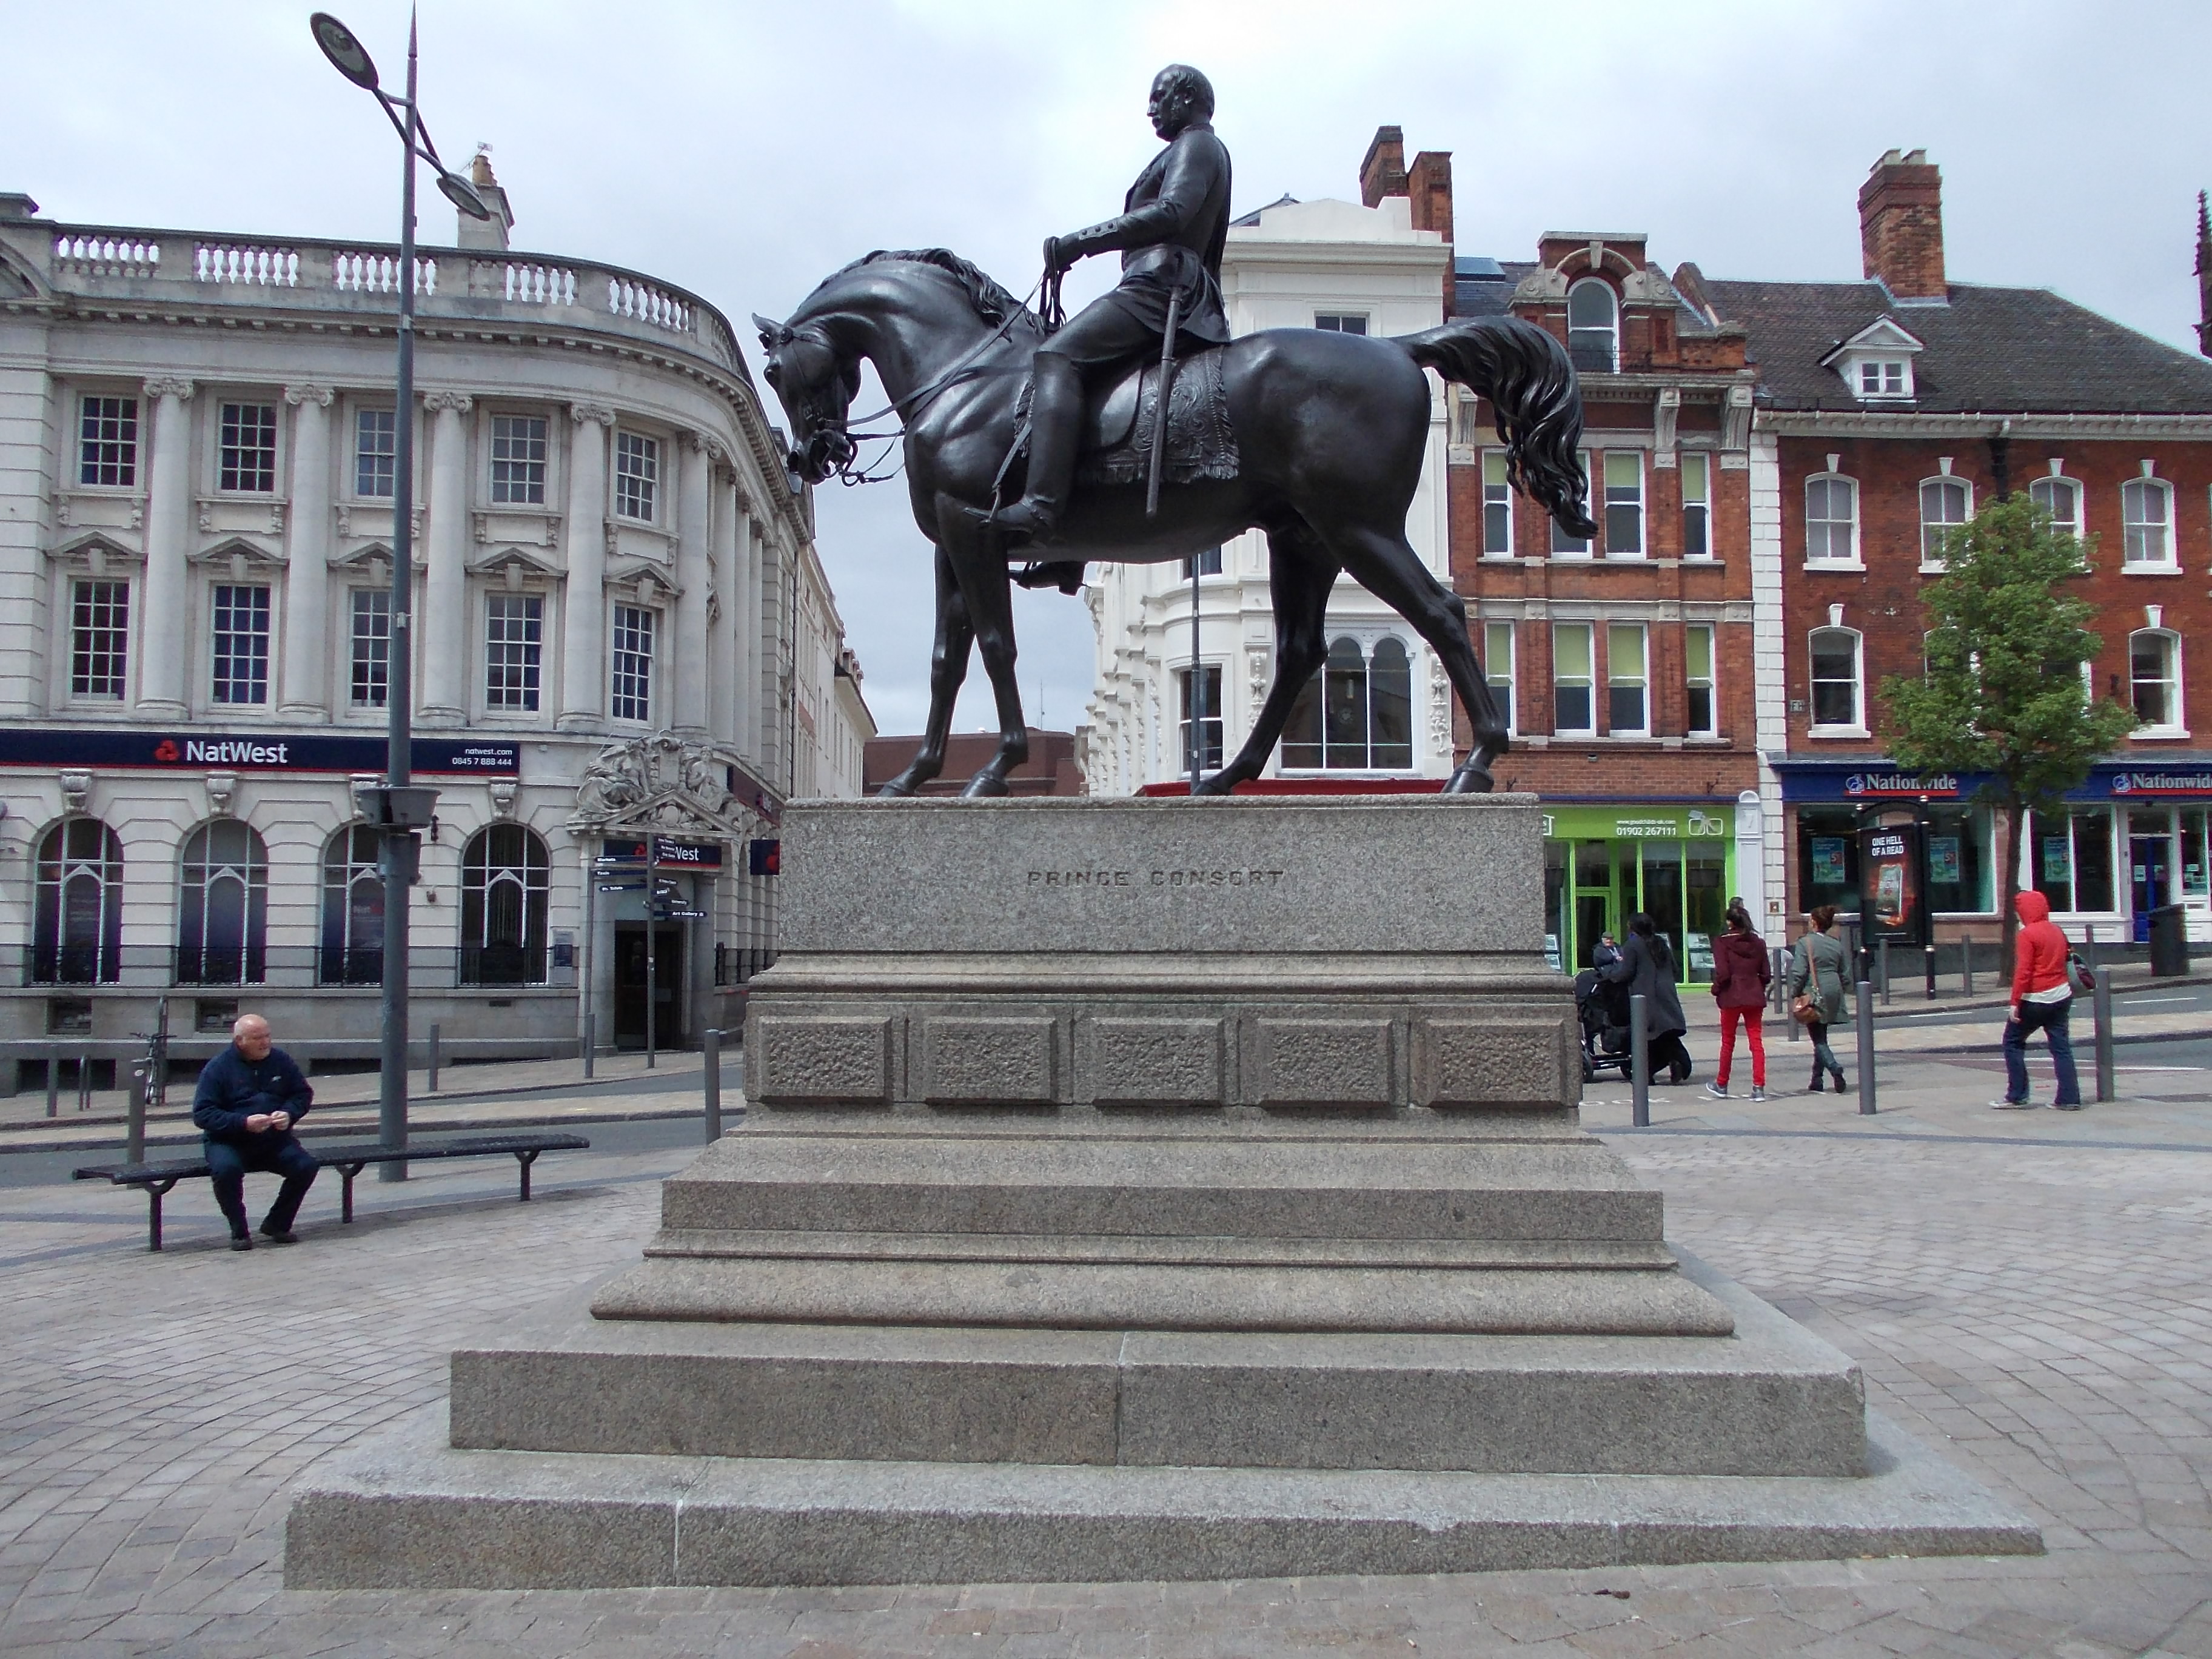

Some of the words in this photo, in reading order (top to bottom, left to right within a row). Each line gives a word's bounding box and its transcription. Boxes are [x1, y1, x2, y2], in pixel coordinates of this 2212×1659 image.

[187, 740, 289, 763] NatWest
[2131, 773, 2212, 788] Nationwid
[1617, 827, 1643, 836] 01902
[1645, 827, 1676, 836] 267111
[1872, 837, 1886, 846] ONE
[1886, 836, 1903, 845] HELL
[1872, 847, 1880, 856] OF
[1886, 845, 1904, 854] READ
[1027, 871, 1130, 886] PRINCE
[1151, 870, 1285, 886] CONSORT
